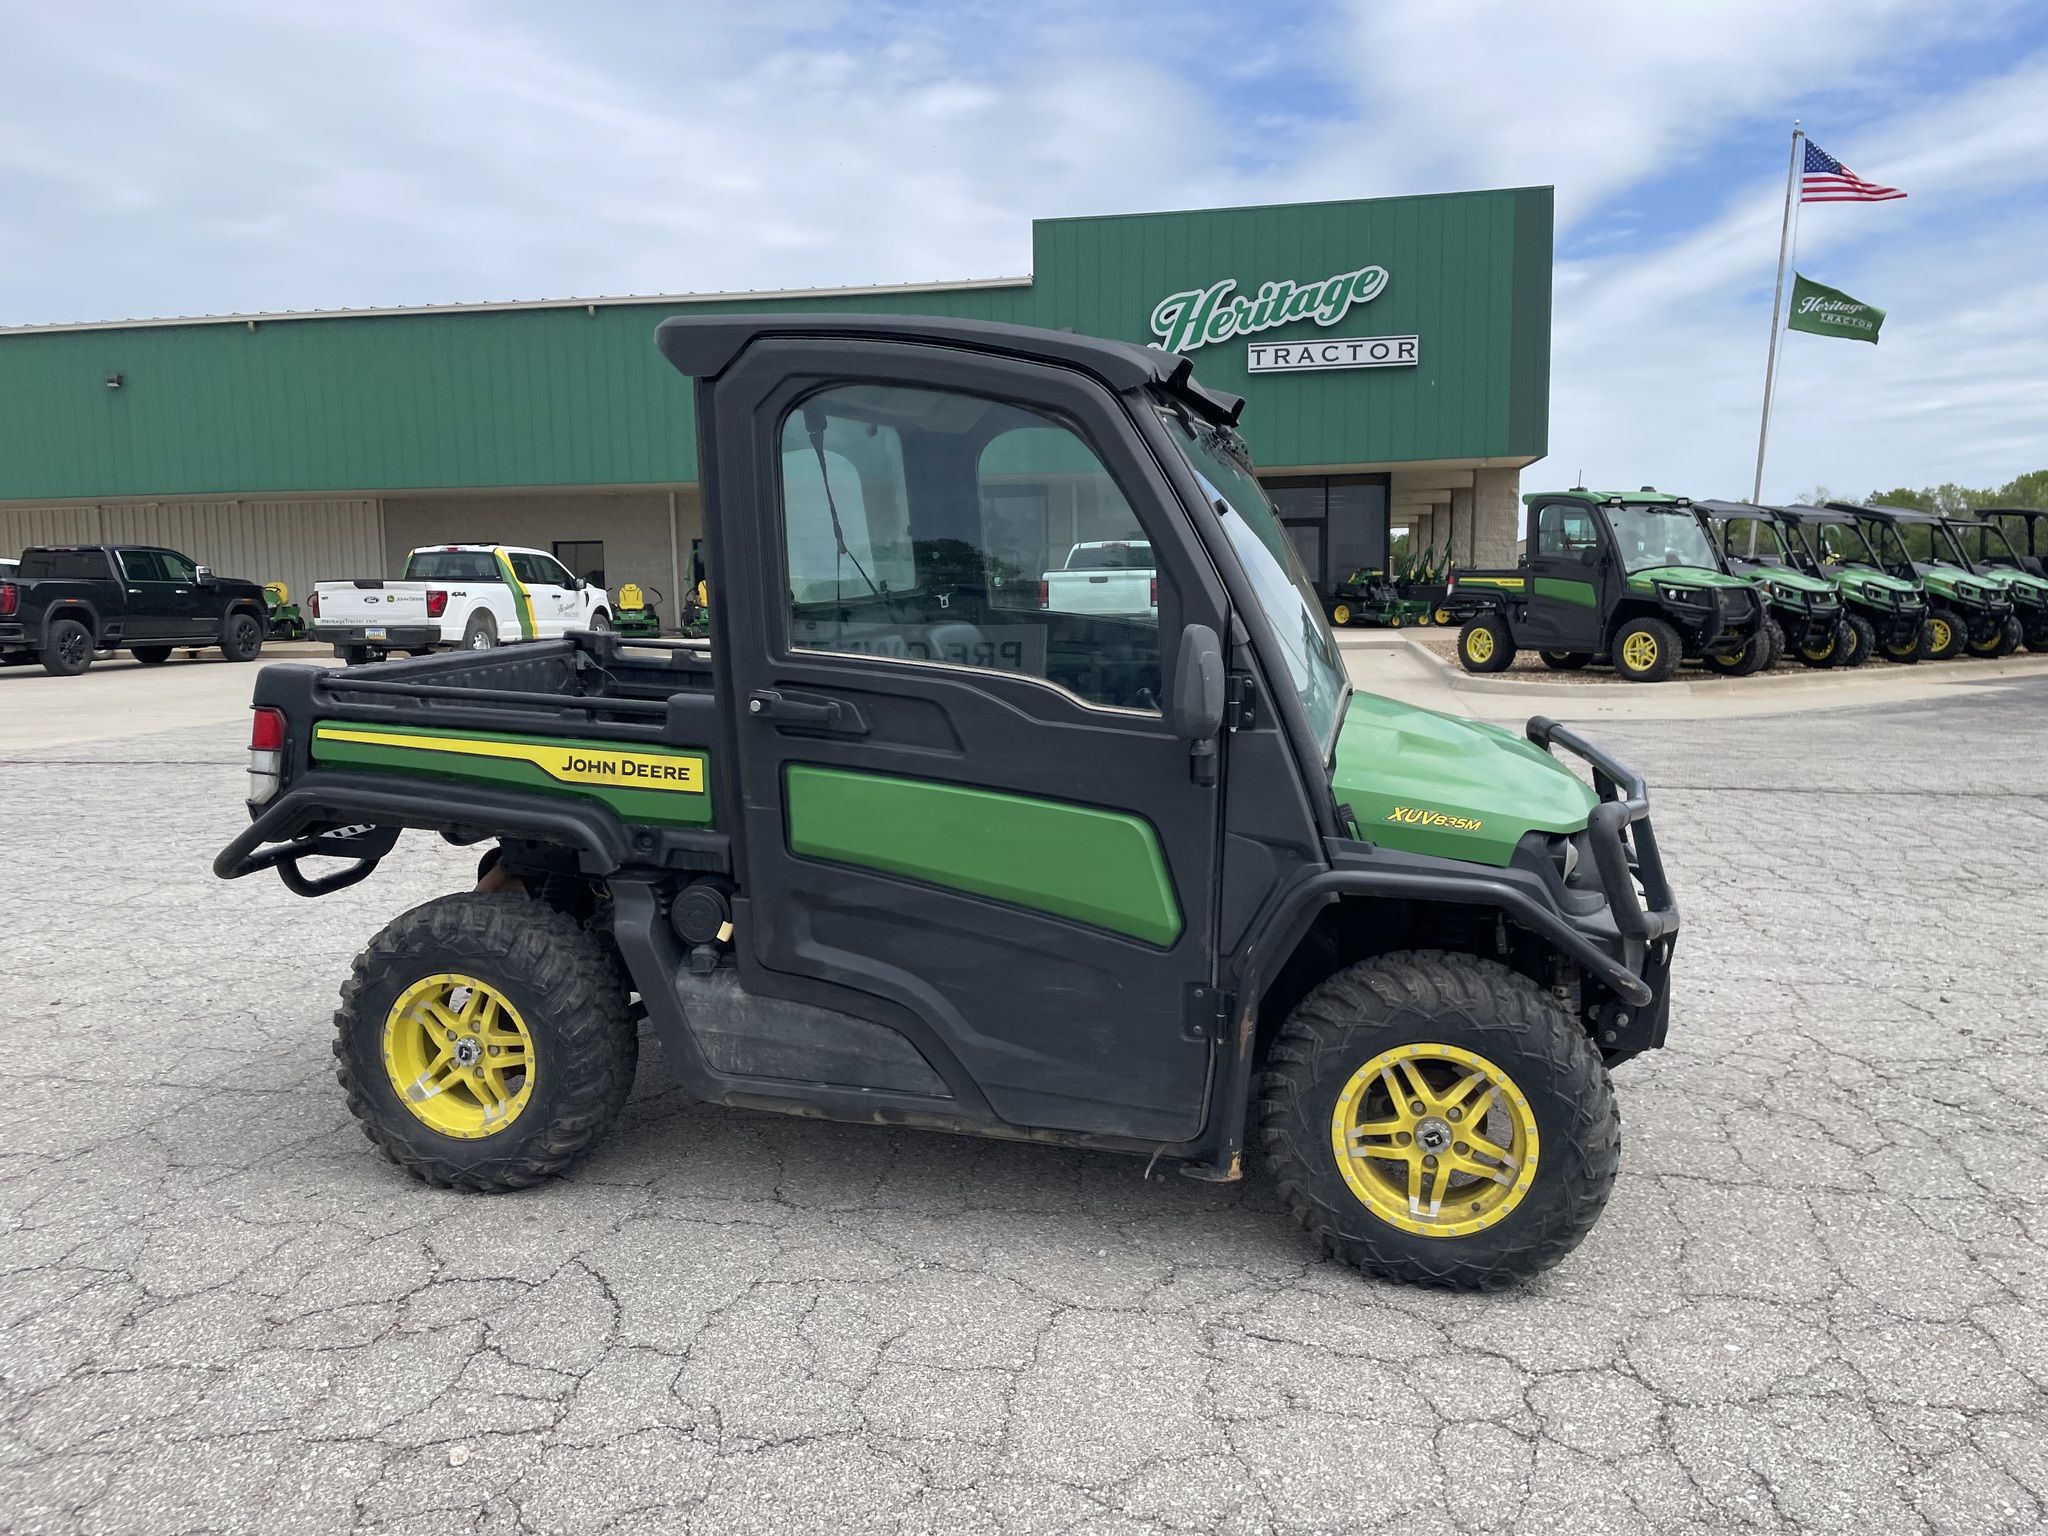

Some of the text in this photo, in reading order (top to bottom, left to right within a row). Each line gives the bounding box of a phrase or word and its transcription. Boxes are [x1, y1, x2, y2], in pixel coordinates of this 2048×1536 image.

[1148, 265, 1389, 354] Heritage
[1798, 296, 1868, 314] Heritage
[1820, 313, 1873, 329] TRACTOR
[1250, 341, 1416, 366] TRACTOR
[562, 755, 690, 781] JOHN DEERE
[1386, 806, 1483, 831] XUV835M
